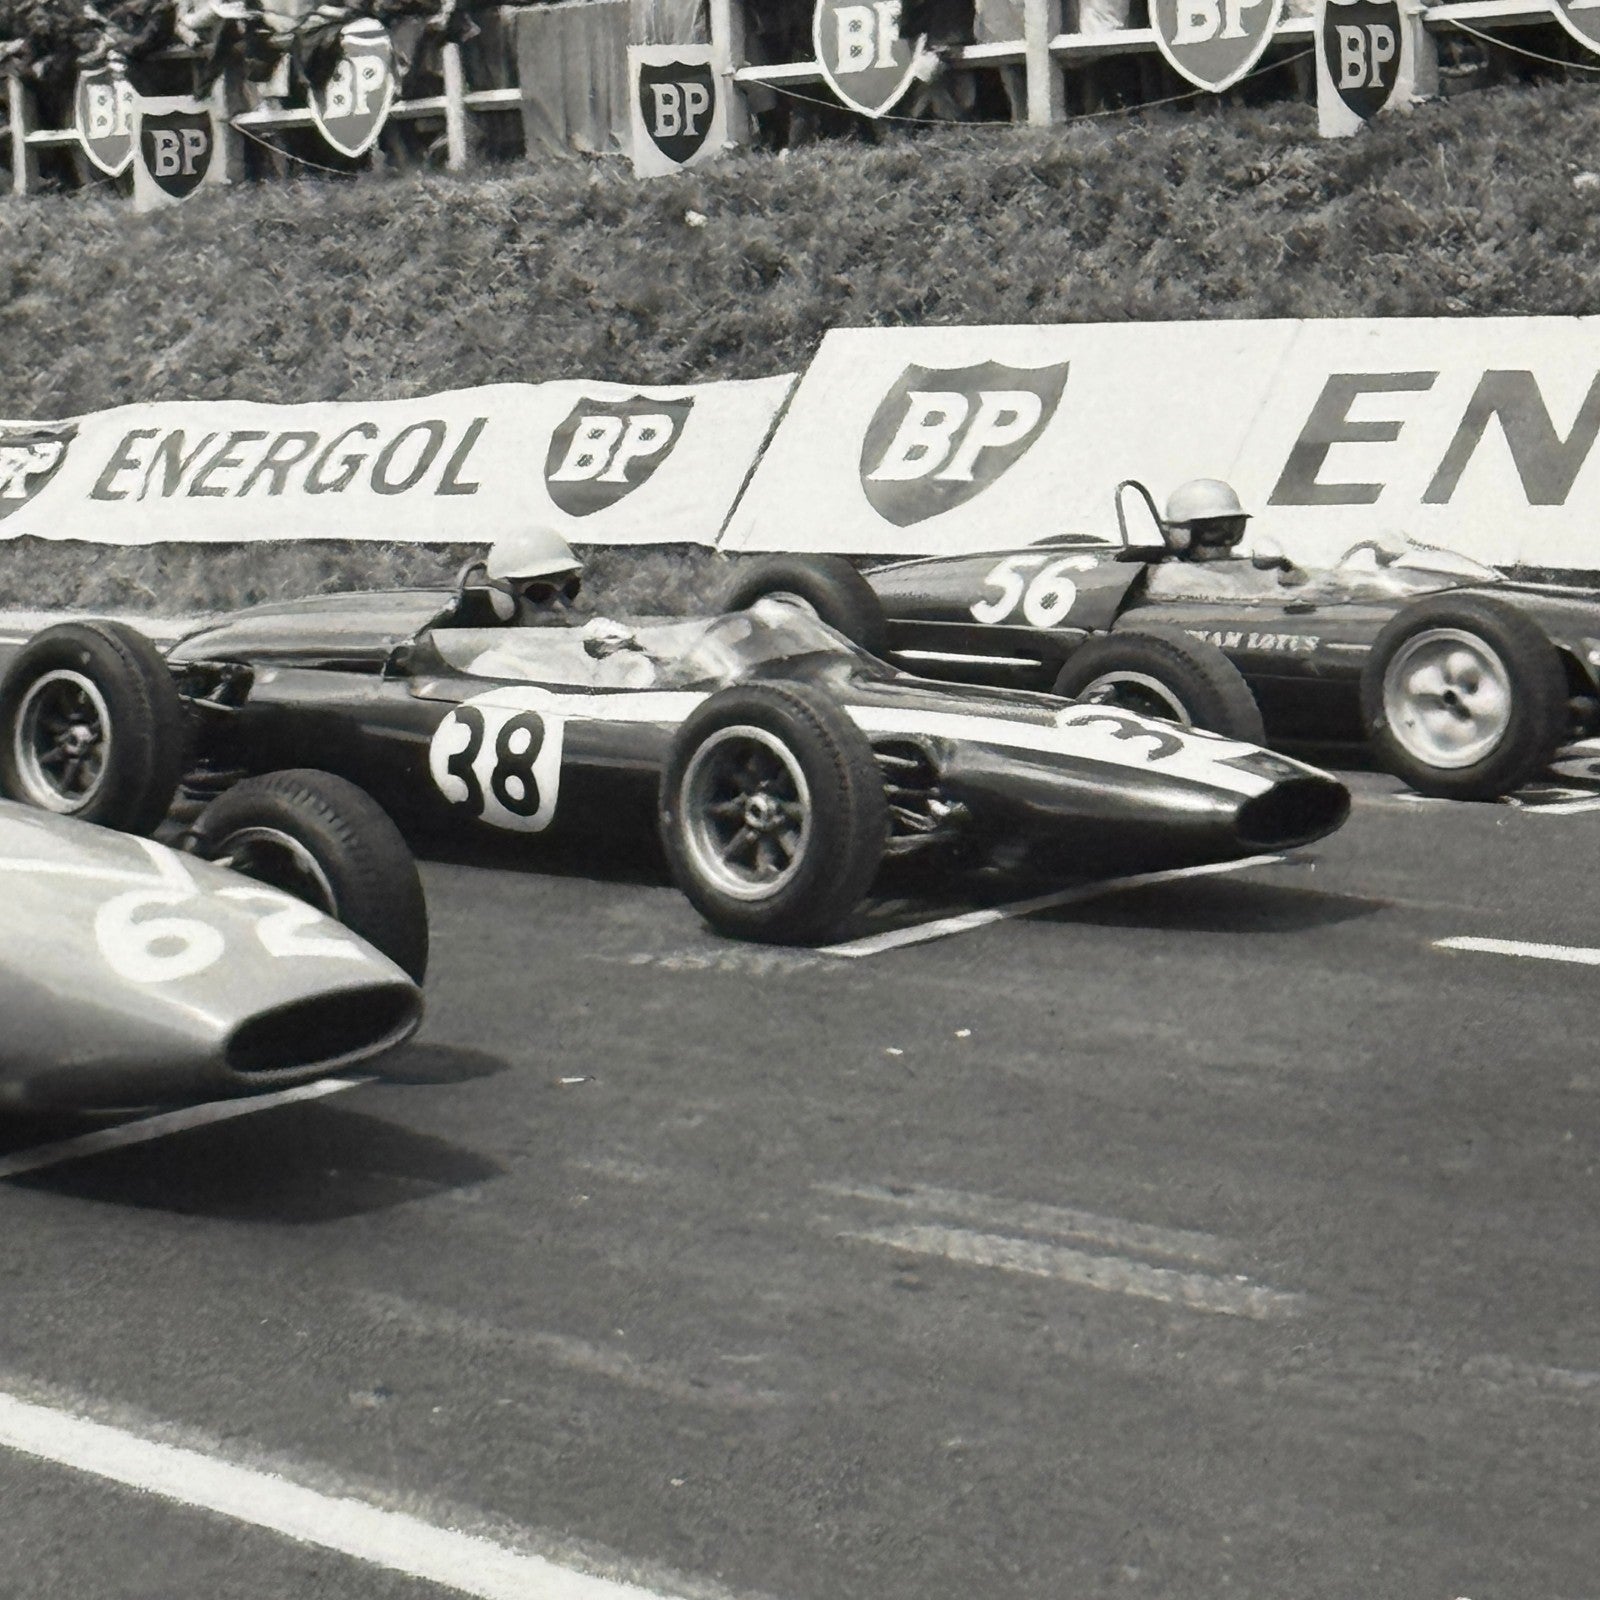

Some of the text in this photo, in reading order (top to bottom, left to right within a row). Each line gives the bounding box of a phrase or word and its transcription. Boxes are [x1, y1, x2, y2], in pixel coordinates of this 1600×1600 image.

[322, 55, 385, 119] BP
[1335, 24, 1395, 89] BP
[650, 82, 709, 137] BP
[153, 128, 207, 176] BP
[90, 417, 488, 500] ENERGOL
[548, 413, 673, 482] BP
[866, 390, 1042, 481] BP
[1267, 368, 1600, 506] EN
[969, 555, 1098, 628] 56
[447, 705, 545, 817] 38
[94, 886, 367, 983] 62
